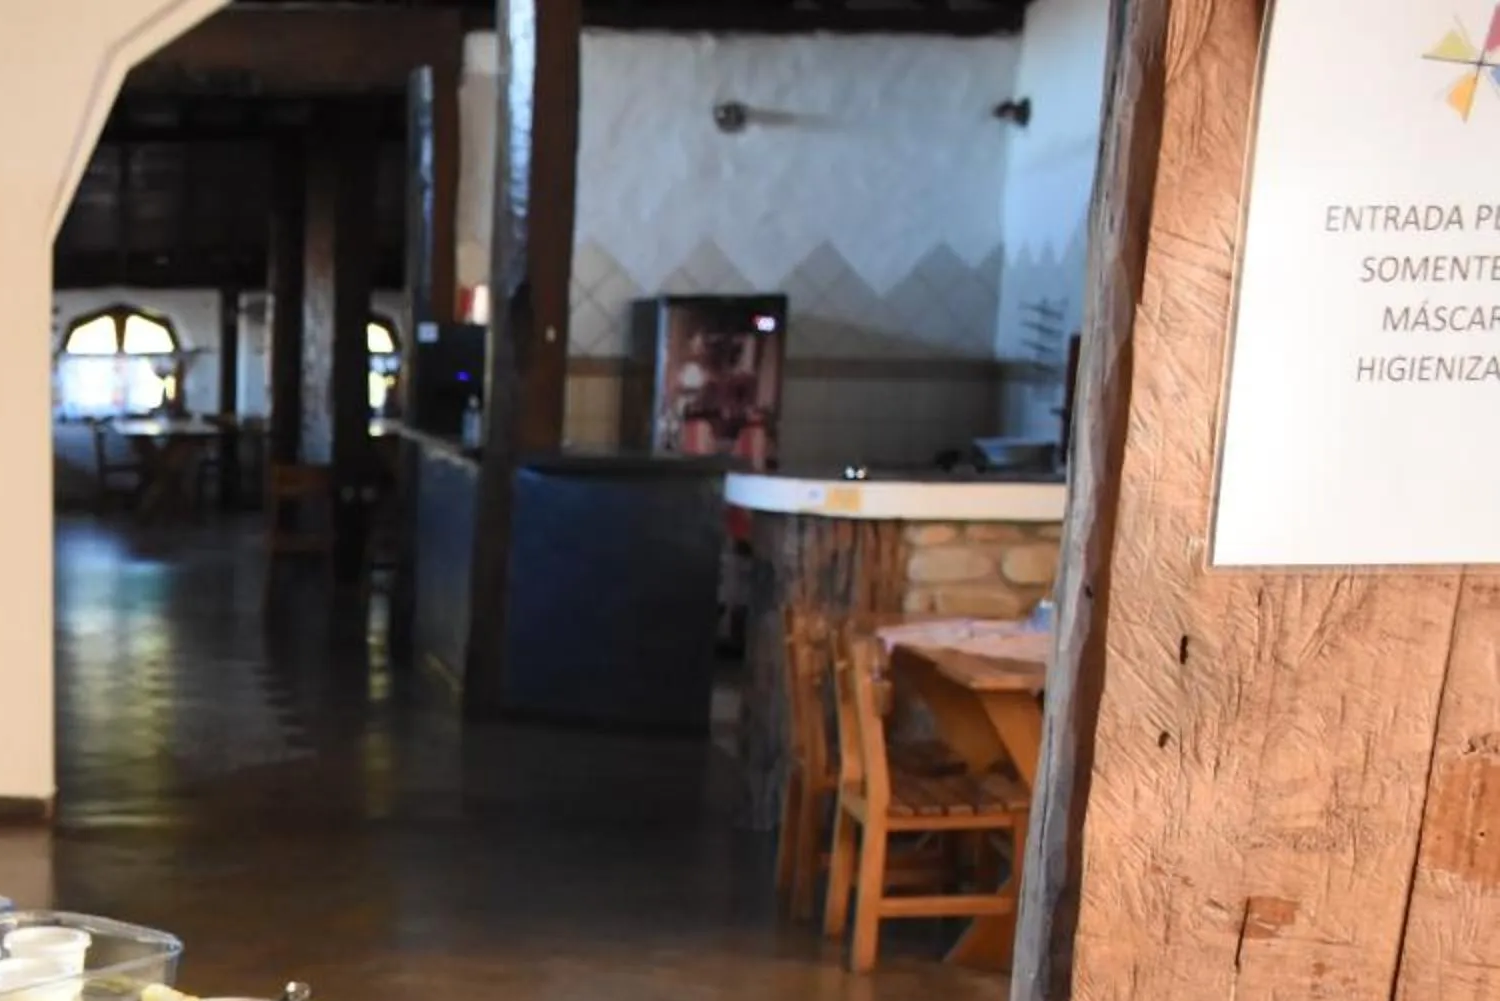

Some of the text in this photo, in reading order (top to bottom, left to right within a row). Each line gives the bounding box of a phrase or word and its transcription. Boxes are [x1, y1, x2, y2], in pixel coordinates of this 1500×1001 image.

[1324, 204, 1464, 232] ENTRADA
[1360, 255, 1500, 282] SOMENTE
[1382, 299, 1500, 331] MÁSCAR
[1356, 355, 1500, 382] HIGIENIZA
